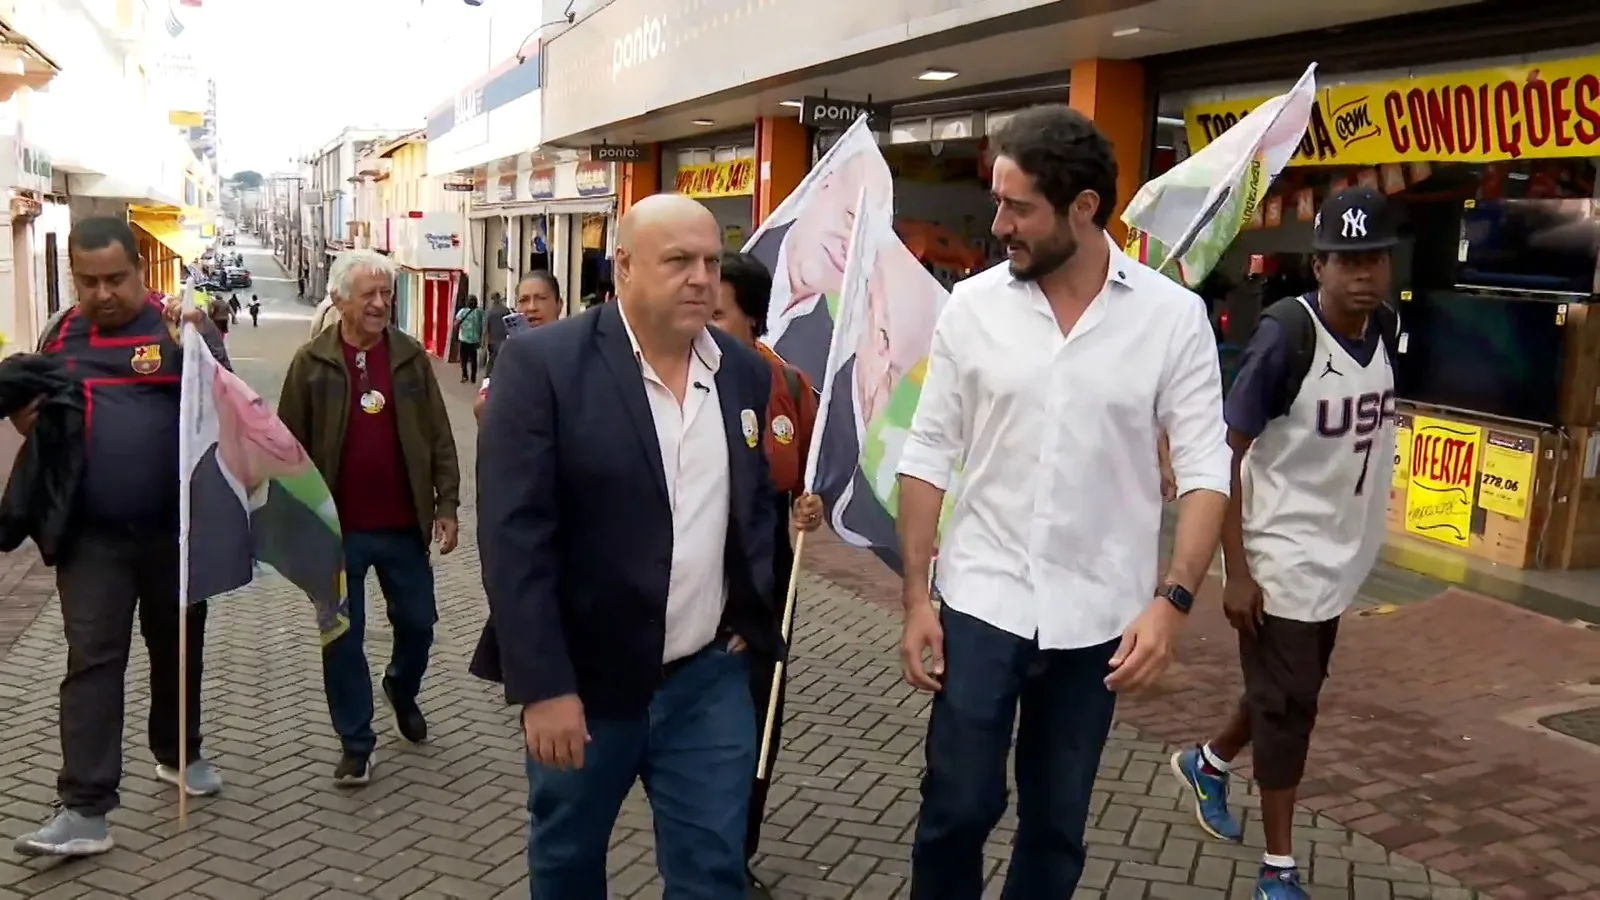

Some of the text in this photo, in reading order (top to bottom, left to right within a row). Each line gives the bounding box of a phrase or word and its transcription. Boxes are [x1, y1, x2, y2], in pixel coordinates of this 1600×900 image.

[613, 14, 667, 83] ponto:
[1385, 69, 1600, 158] CONDIÇÕES
[1353, 438, 1373, 496] 7
[1412, 432, 1475, 488] OFERTA
